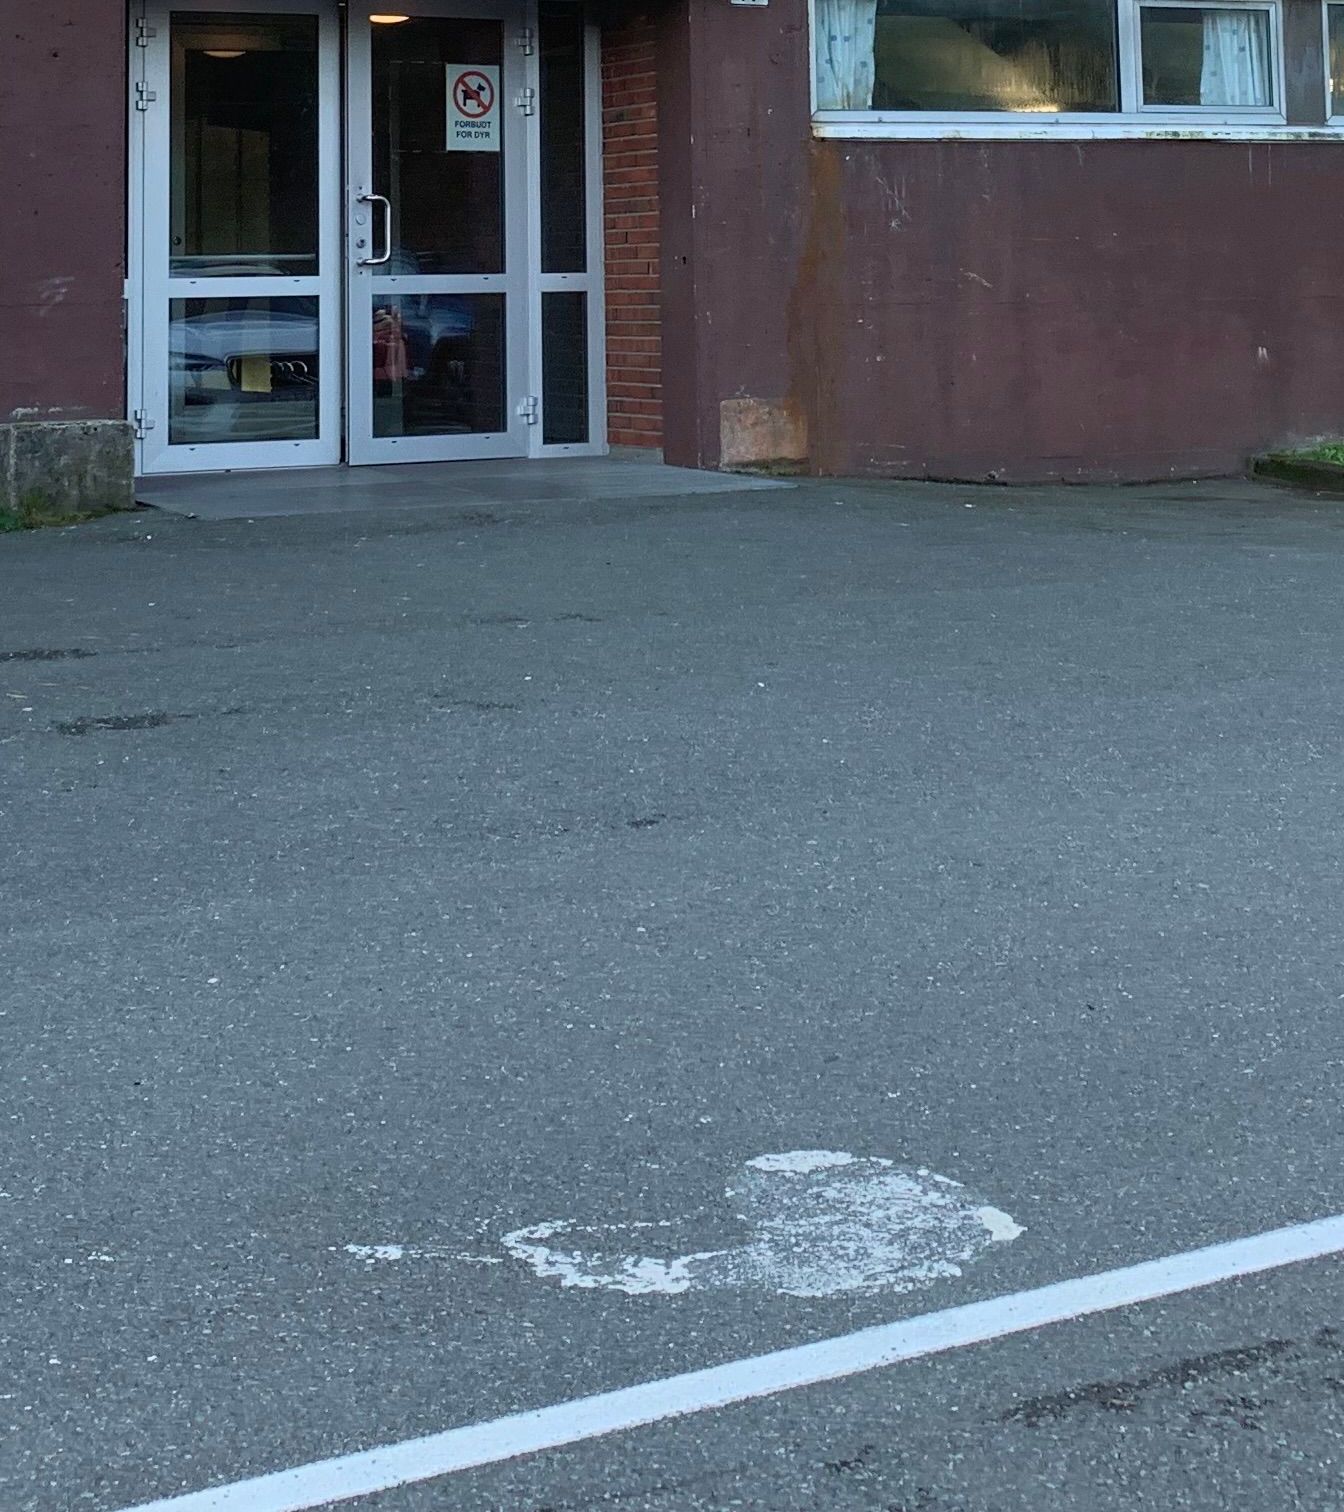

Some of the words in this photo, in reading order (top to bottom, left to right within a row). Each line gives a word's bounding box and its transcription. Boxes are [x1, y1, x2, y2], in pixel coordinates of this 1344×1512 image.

[454, 120, 492, 128] FORBUDT
[456, 130, 472, 139] FOR
[474, 131, 490, 139] DYR
